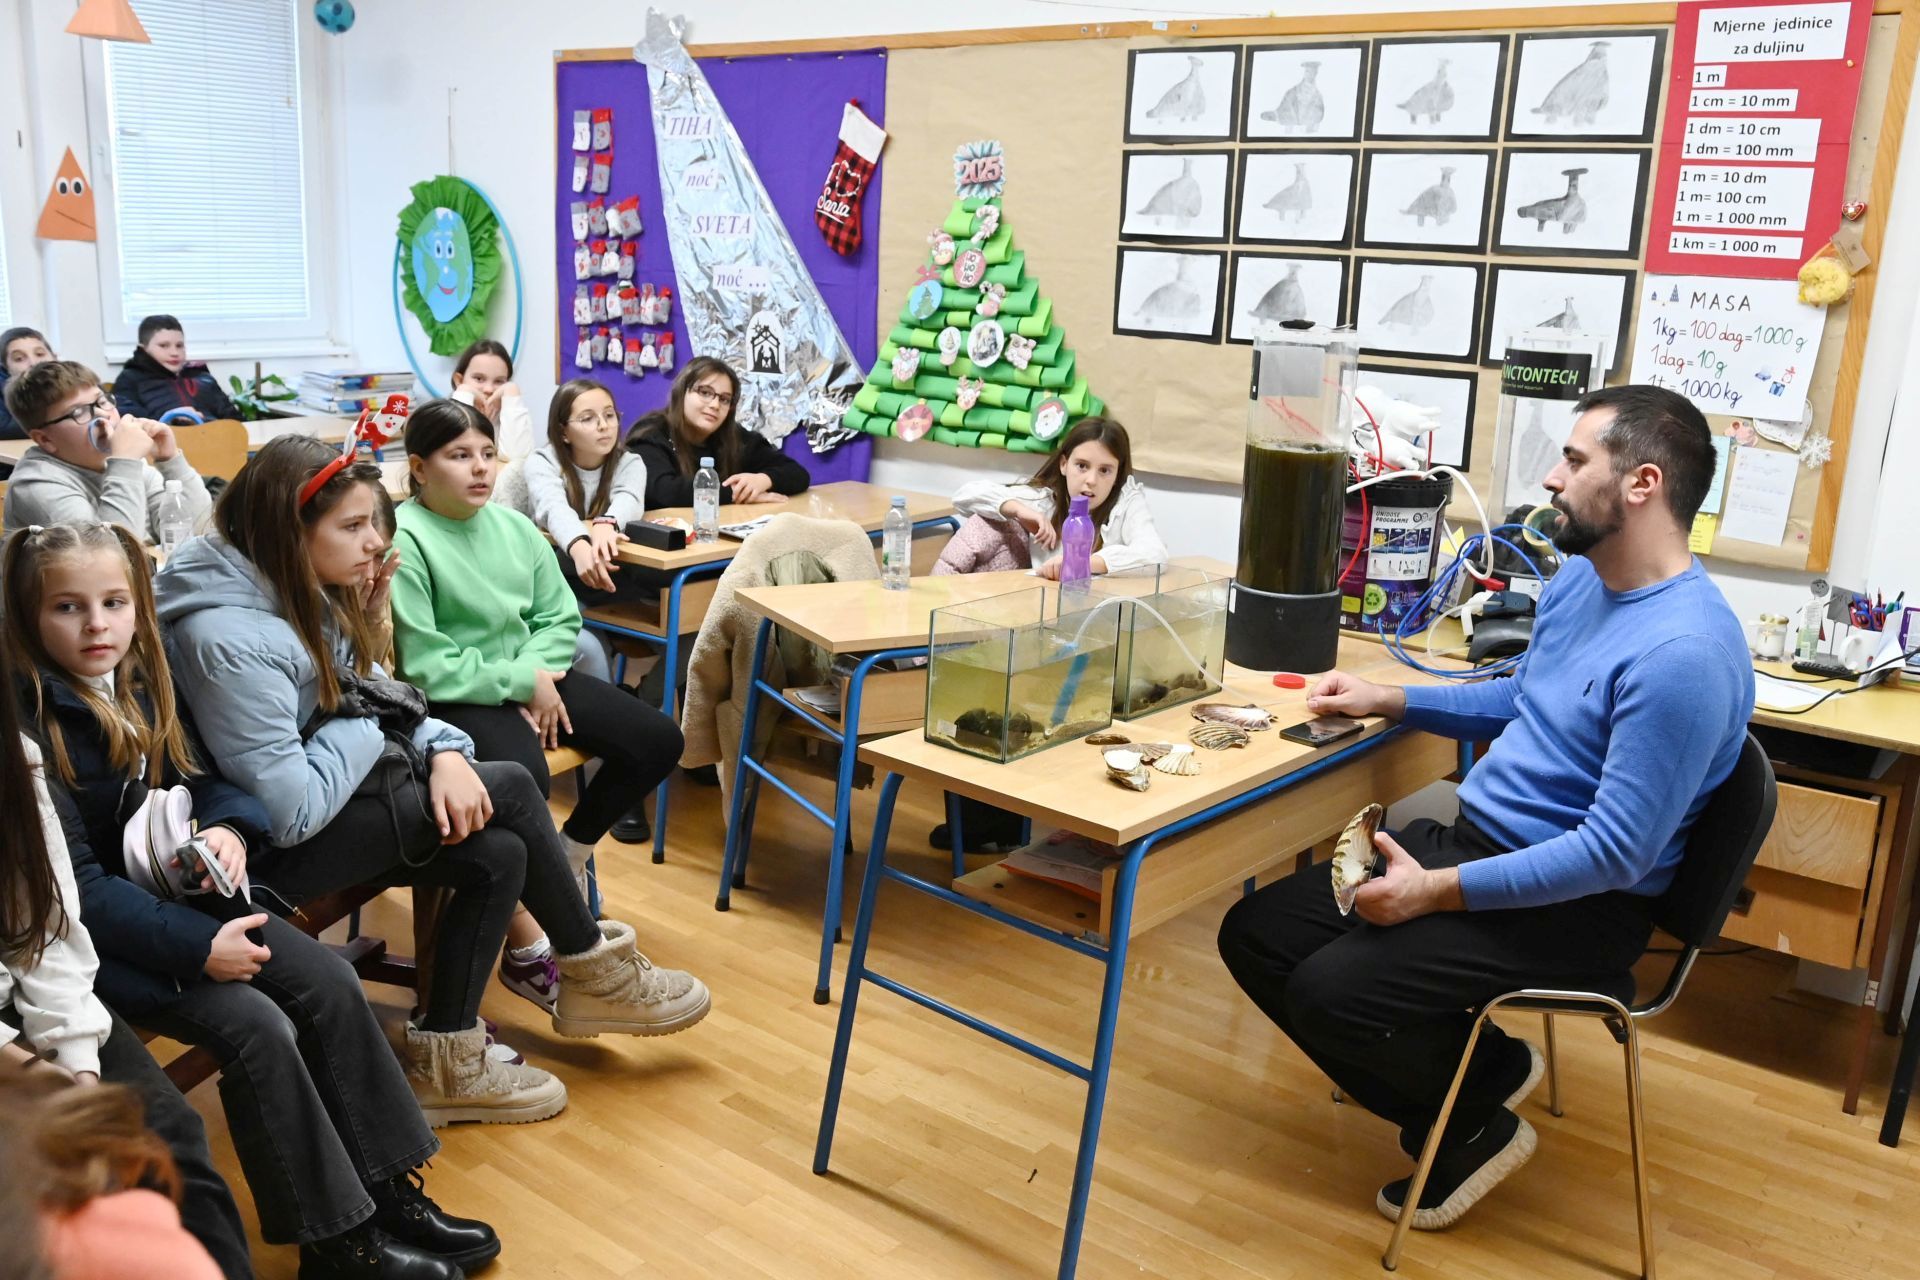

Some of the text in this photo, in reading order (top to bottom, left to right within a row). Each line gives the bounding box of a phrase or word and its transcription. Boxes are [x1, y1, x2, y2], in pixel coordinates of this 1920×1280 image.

[1713, 16, 1832, 35] Mjerne jedinice
[1733, 41, 1804, 56] za duljinu
[1695, 72, 1720, 83] 1 m
[1691, 96, 1698, 106] 1
[1703, 97, 1723, 106] cm
[1741, 95, 1757, 106] 10
[1762, 97, 1790, 106] mm
[669, 117, 712, 136] TIHA
[1687, 123, 1694, 134] 1
[1699, 123, 1721, 134] dm
[1739, 123, 1755, 135] 10
[1760, 126, 1781, 135] cm
[1685, 143, 1691, 154] 1
[1696, 143, 1718, 154] dm
[1736, 144, 1761, 156] 100
[1765, 147, 1793, 156] mm
[686, 169, 714, 186] noć
[960, 157, 1001, 185] 2025
[1681, 171, 1688, 181] 1
[1693, 173, 1706, 182] m
[1723, 172, 1739, 183] 10
[1744, 172, 1767, 184] dm
[817, 186, 850, 217] Santa
[1678, 191, 1685, 201] 1
[1716, 192, 1741, 203] 100
[1745, 195, 1766, 204] cm
[693, 215, 750, 234] SVETA
[1675, 211, 1682, 222] 1
[1687, 213, 1700, 222] m
[1759, 215, 1787, 226] mm
[1671, 238, 1678, 248] 1
[1683, 237, 1704, 249] km
[1762, 244, 1776, 253] m
[716, 270, 743, 287] noć
[1690, 292, 1751, 312] MASA
